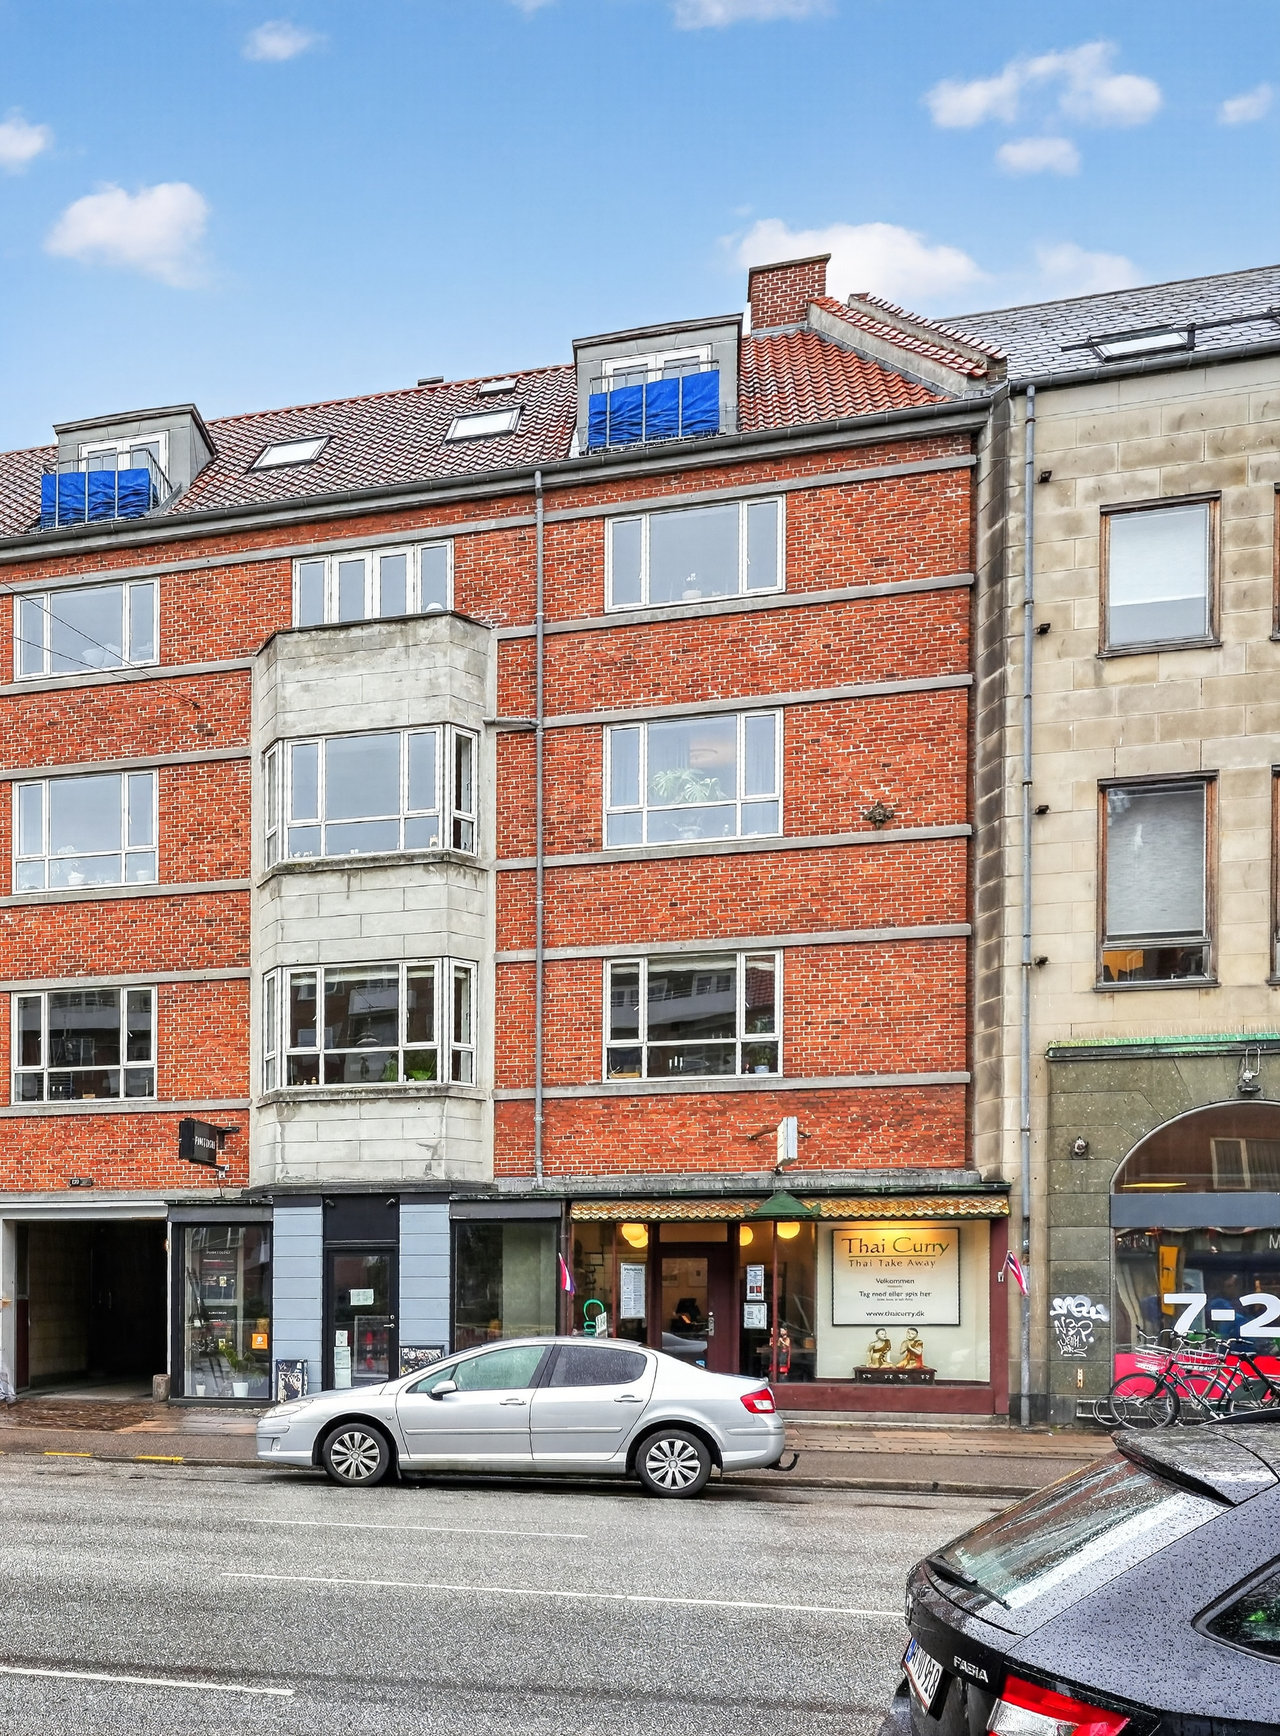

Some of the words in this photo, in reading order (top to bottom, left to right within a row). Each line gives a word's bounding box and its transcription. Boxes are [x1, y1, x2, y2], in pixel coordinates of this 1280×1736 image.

[841, 1238, 885, 1254] Thai
[892, 1236, 950, 1256] Curry
[848, 1259, 873, 1267] Thai
[879, 1259, 903, 1267] Take
[907, 1259, 936, 1268] Away
[866, 1310, 925, 1318] www.thaicurry.dk
